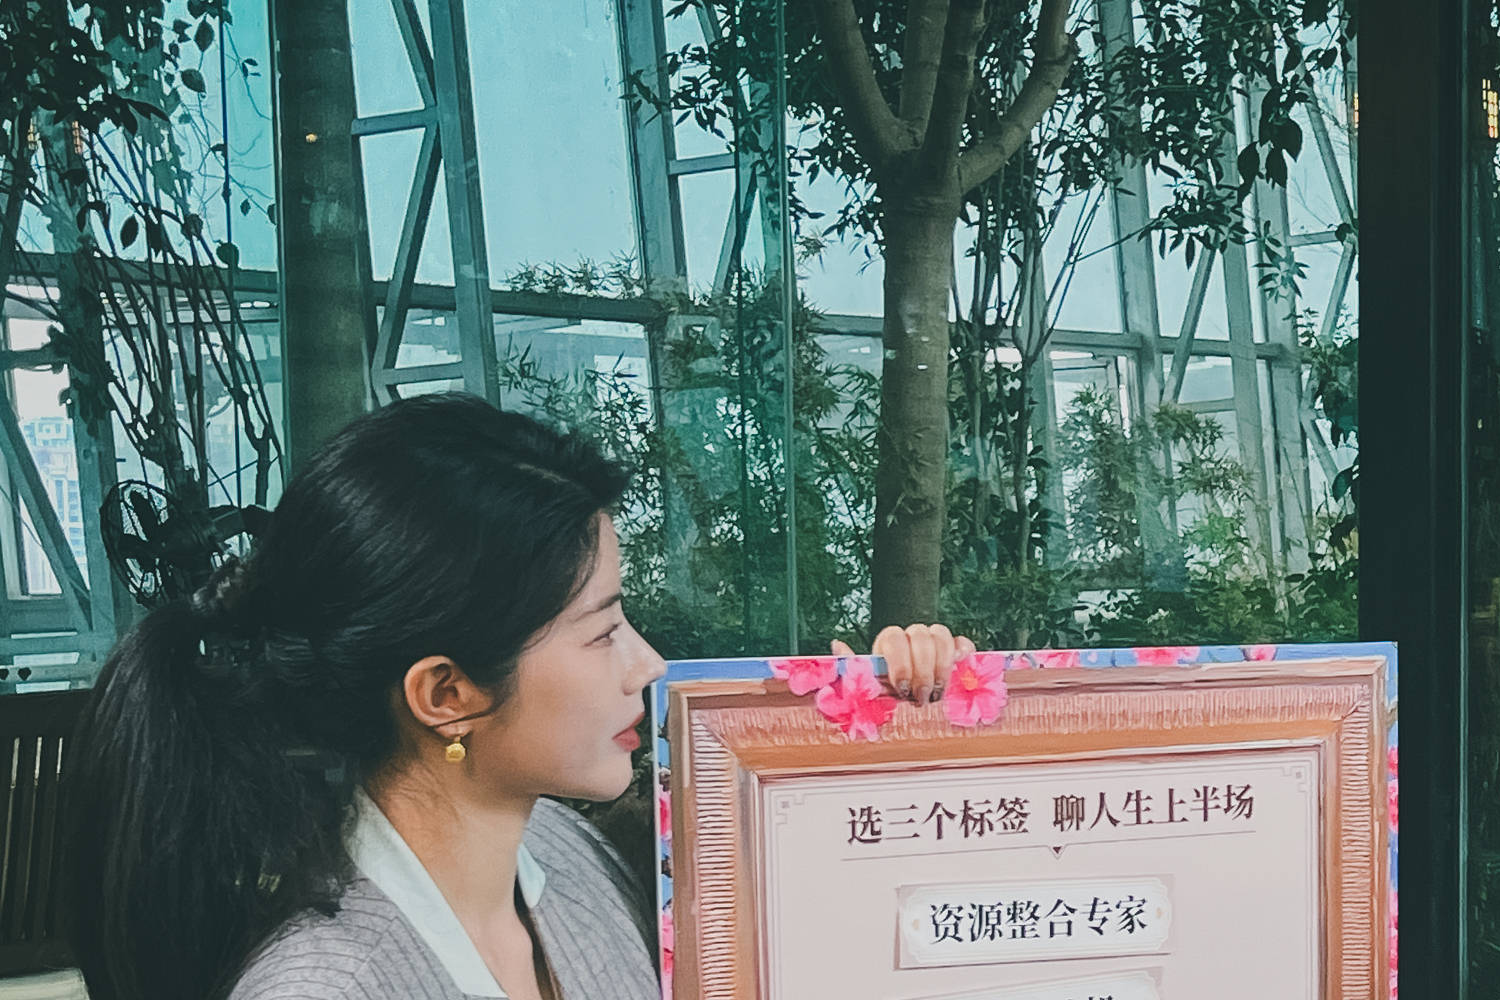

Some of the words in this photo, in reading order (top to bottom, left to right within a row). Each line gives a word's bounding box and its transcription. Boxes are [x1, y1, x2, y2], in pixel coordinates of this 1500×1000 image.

[847, 797, 1030, 845] 选三个标签
[1053, 783, 1255, 832] 聊人生上半场
[930, 895, 1148, 944] 资源整合专家
